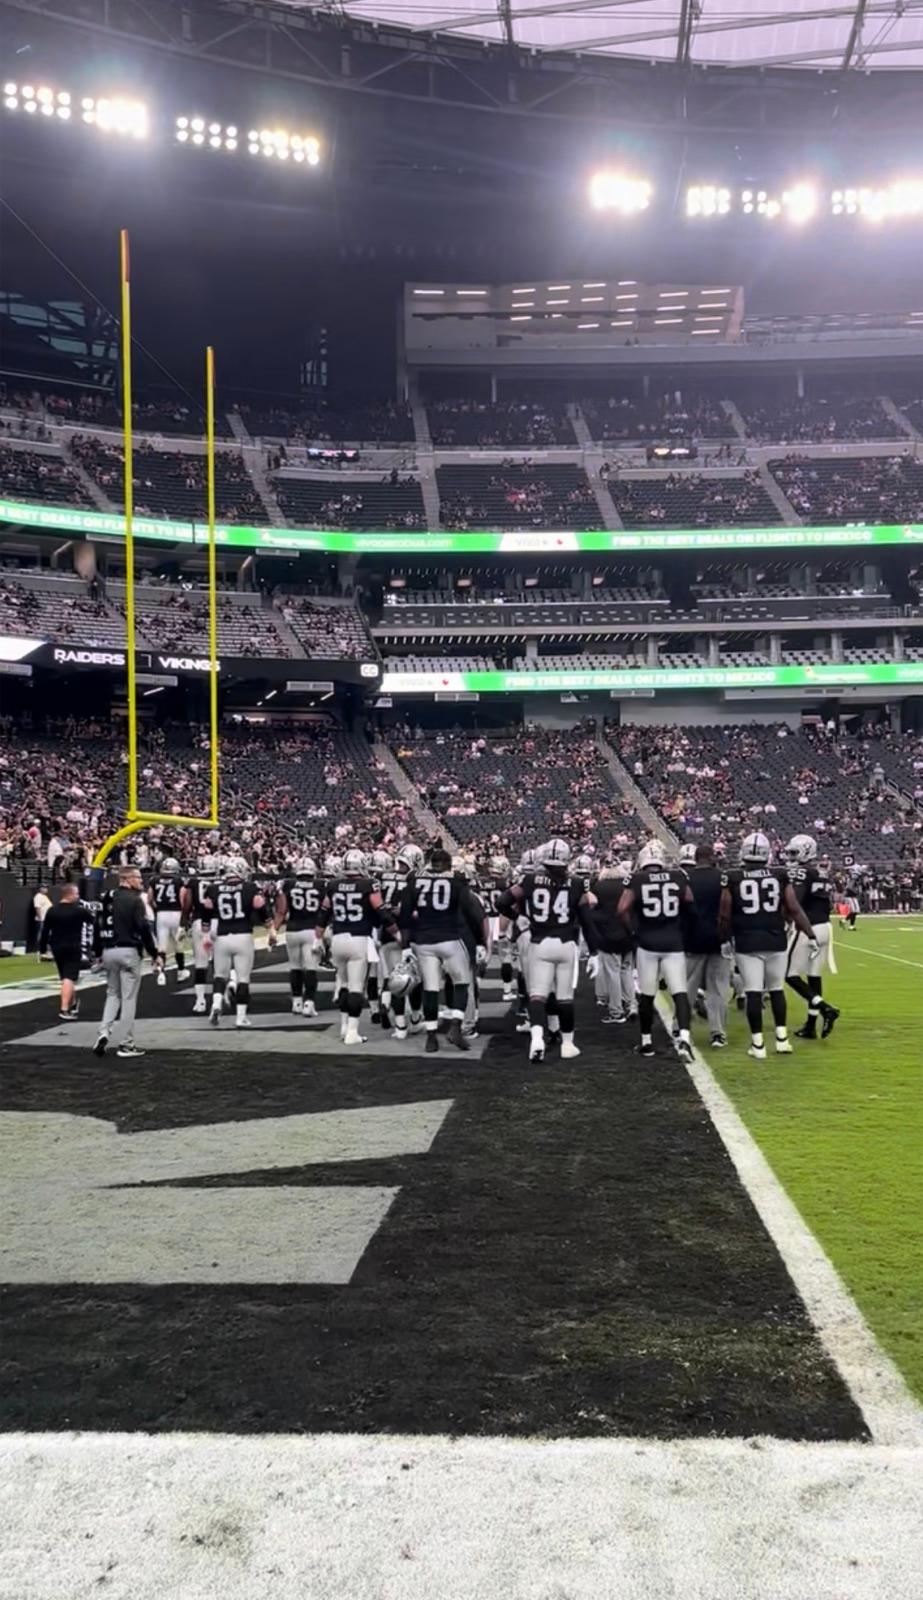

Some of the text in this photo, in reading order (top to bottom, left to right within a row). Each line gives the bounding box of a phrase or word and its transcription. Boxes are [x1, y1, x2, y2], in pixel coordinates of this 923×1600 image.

[696, 534, 735, 545] DEALS
[736, 533, 754, 544] ON
[805, 532, 823, 542] TO
[54, 648, 221, 672] RAIDERS VIKINGS
[593, 674, 633, 685] DEALS
[635, 674, 654, 684] ON
[655, 673, 704, 684] FLIGHTS
[707, 672, 725, 682] TO
[726, 671, 775, 682] MEXICO
[155, 883, 177, 902] 74
[217, 891, 246, 920] 61
[290, 888, 320, 912] 66
[331, 892, 364, 922] 65
[415, 879, 451, 911] 70
[532, 888, 570, 924] 94
[641, 882, 680, 918] 56
[740, 878, 780, 914] 93
